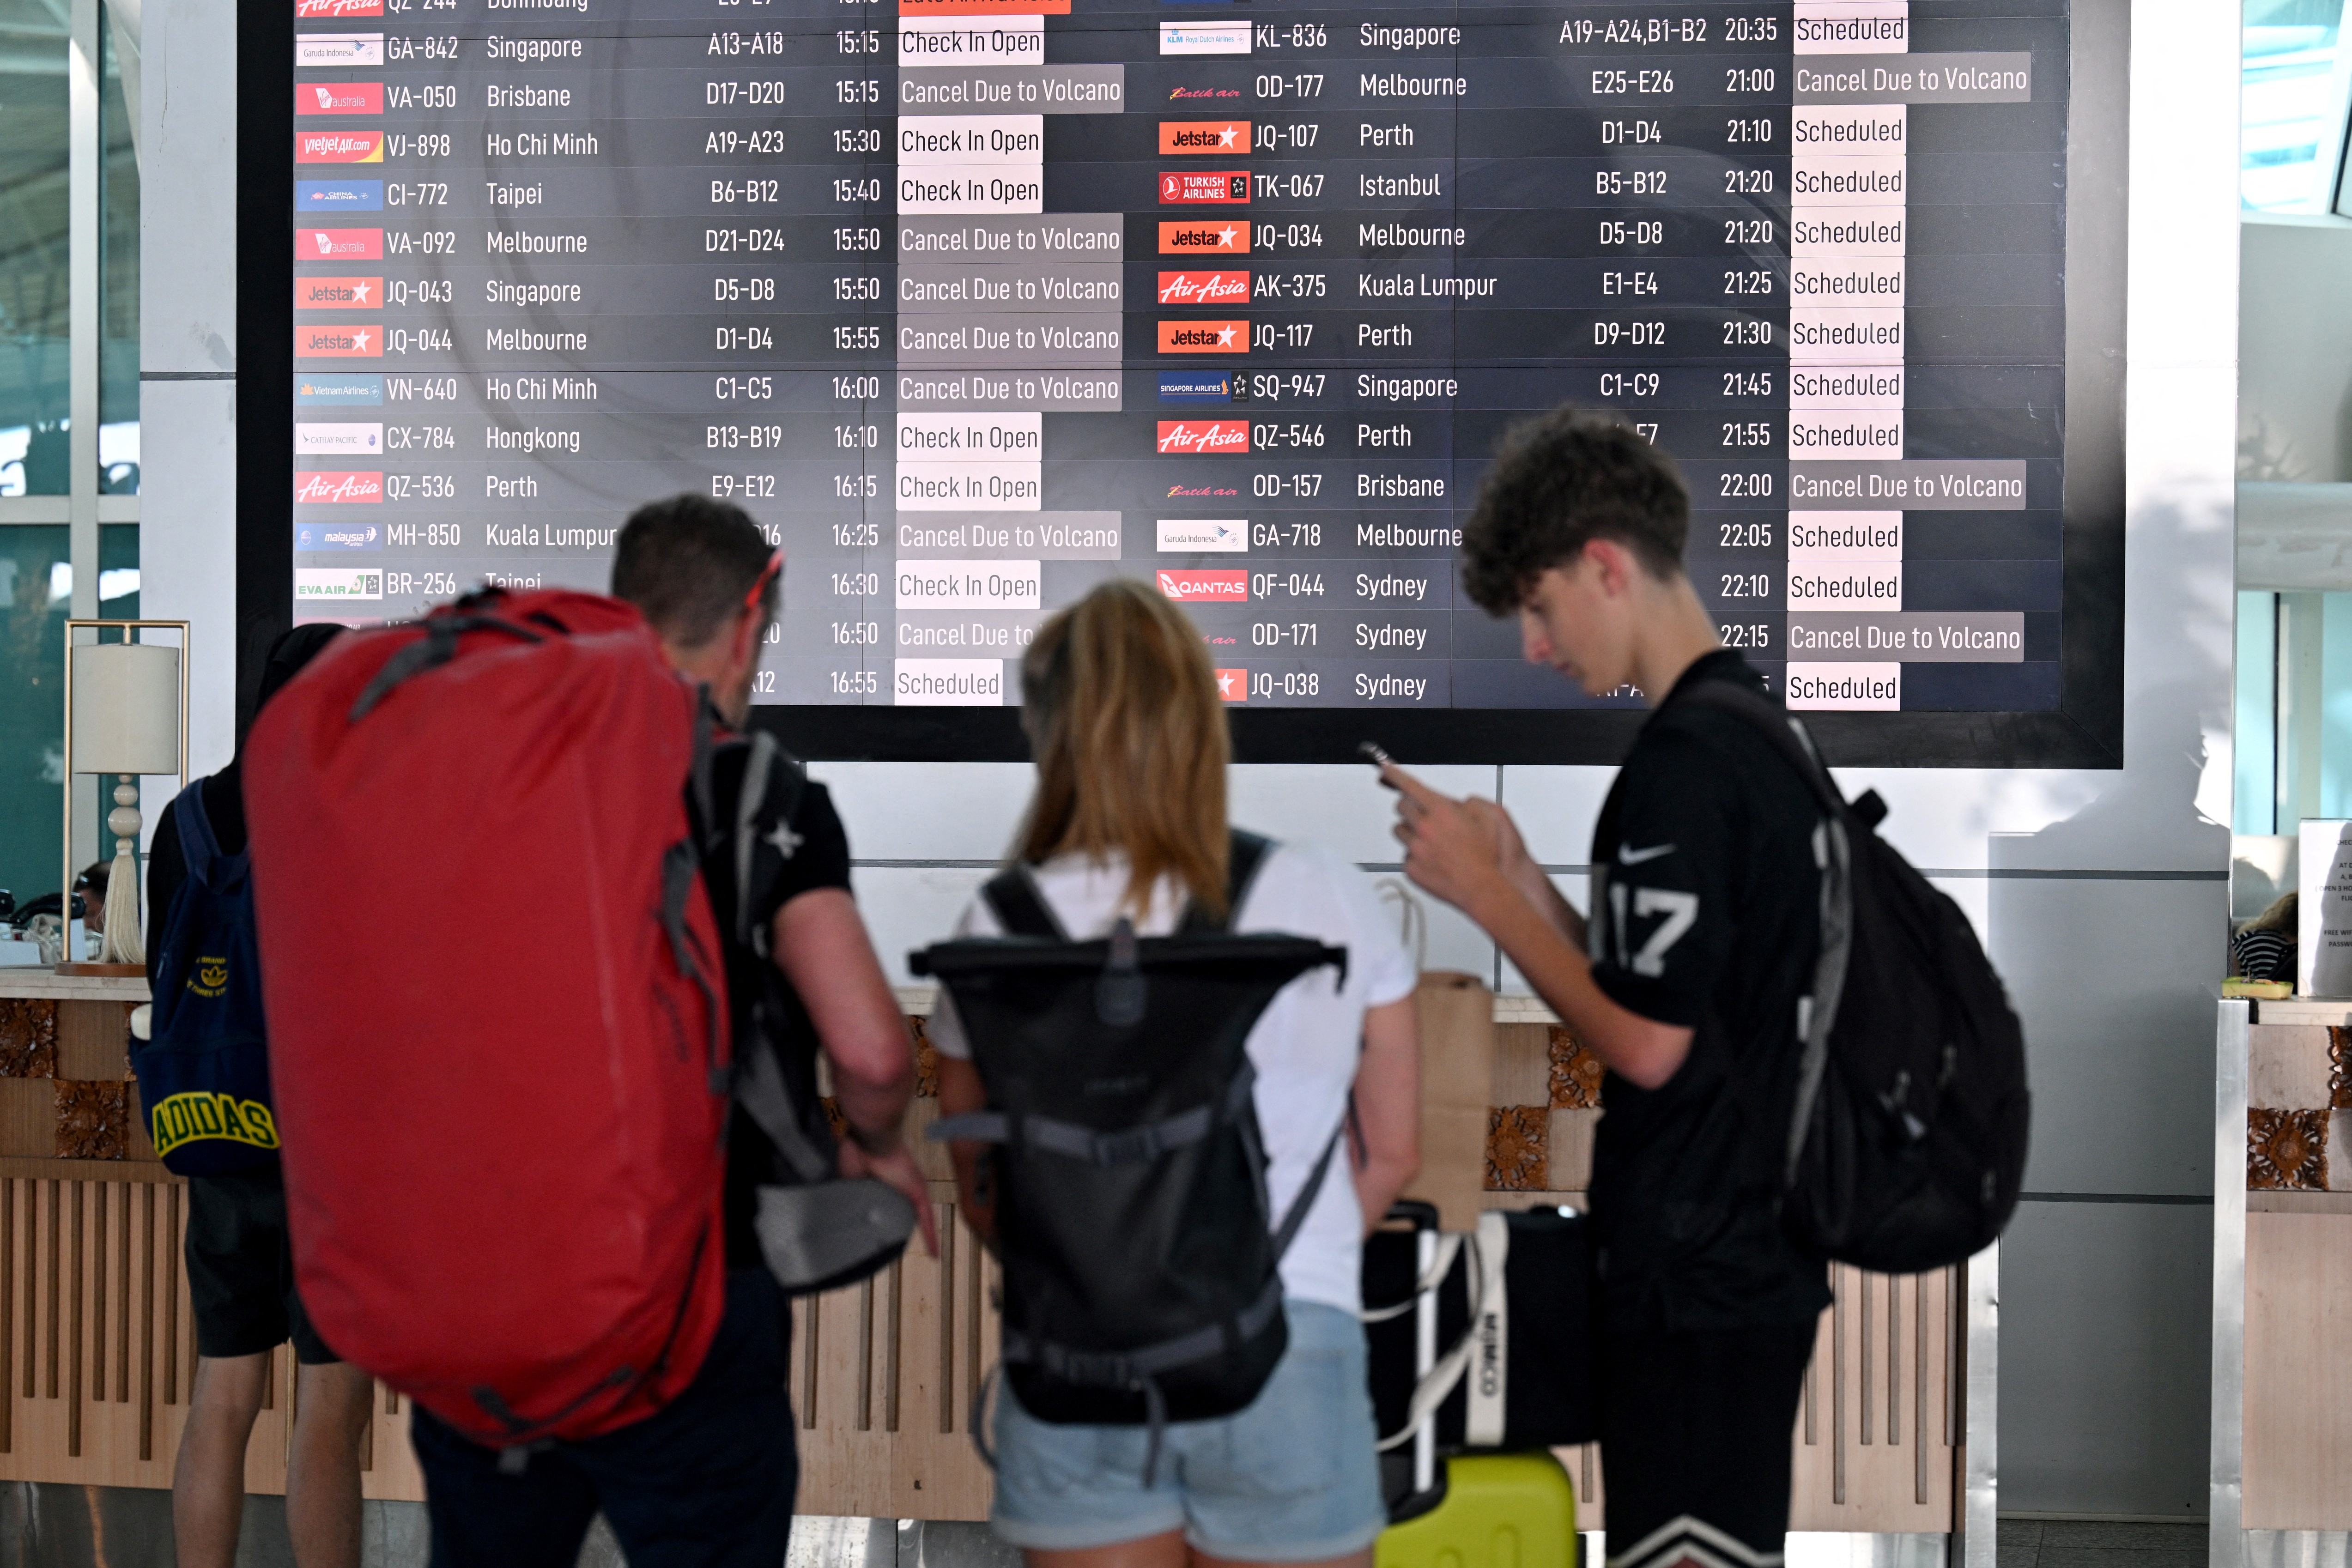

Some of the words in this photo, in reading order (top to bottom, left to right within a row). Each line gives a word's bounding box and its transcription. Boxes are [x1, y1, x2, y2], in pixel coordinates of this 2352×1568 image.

[1257, 24, 1327, 48] KL-836
[1360, 23, 1460, 50] Singapore
[1559, 18, 1706, 46] A19-A24,B1-B2
[1725, 17, 1777, 41] 20:35
[1797, 18, 1903, 41] Scheduled
[303, 49, 325, 57] Garuda
[388, 36, 458, 60] GA-842
[487, 36, 582, 62] Singapore
[708, 31, 783, 55] A13-A18
[837, 30, 879, 54] 15:15
[902, 80, 969, 103] Cancel
[975, 80, 1011, 102] Due
[1017, 81, 1037, 102] to
[1042, 79, 1119, 101] Volcano
[1256, 74, 1324, 97] OD-177
[1361, 73, 1466, 96] Melbourne
[1592, 70, 1673, 93] E25-E26
[1727, 68, 1774, 91] 21:00
[1797, 69, 1867, 92] Cancel
[1874, 68, 1912, 91] Due
[1918, 69, 1939, 90] to
[1945, 67, 2027, 90] Volcano
[332, 96, 365, 107] australia
[388, 85, 456, 108] VA-050
[488, 85, 570, 107] Brisbane
[707, 81, 784, 104] D17-D20
[836, 80, 879, 103] 15:15
[705, 130, 783, 153] A19-A23
[834, 129, 880, 152] 15:30
[902, 130, 962, 152] Check
[969, 130, 984, 151] In
[991, 129, 1038, 155] Open
[1173, 131, 1221, 146] Jetstar
[1255, 124, 1318, 151] JQ-107
[1360, 123, 1413, 146] Perth
[1602, 121, 1661, 144] D1-D4
[1727, 119, 1771, 142] 21:10
[1796, 119, 1902, 142] Scheduled
[387, 134, 450, 157] VJ-898
[488, 134, 511, 156] Ho
[517, 133, 546, 155] Chi
[553, 133, 598, 155] Minh
[712, 180, 778, 203] B6-B12
[833, 179, 880, 201] 15:40
[1183, 177, 1224, 187] TURKISH
[1183, 188, 1224, 199] AIRLINES
[1255, 175, 1324, 197] TK-067
[1360, 173, 1441, 196] Istanbul
[1597, 171, 1667, 194] B5-B12
[388, 183, 448, 206] CI-772
[486, 182, 541, 209] Taipei
[487, 231, 587, 253] Melbourne
[706, 229, 785, 251] D21-D24
[1172, 230, 1220, 246] Jetstar
[1255, 224, 1323, 251] JQ-034
[1359, 224, 1465, 246] Melbourne
[1725, 220, 1772, 243] 21:20
[332, 242, 364, 252] australia
[308, 286, 355, 301] Jetstar
[387, 280, 452, 306] JQ-043
[486, 280, 581, 306] Singapore
[715, 278, 774, 301] D5-D8
[833, 277, 879, 300] 15:50
[1254, 274, 1326, 297] AK-375
[1359, 274, 1414, 297] Kuala
[1421, 273, 1497, 300] Lumpur
[1603, 272, 1658, 295] E1-E4
[308, 334, 354, 349] Jetstar
[487, 328, 587, 351] Melbourne
[1171, 330, 1219, 345] Jetstar
[1359, 323, 1412, 346] Perth
[1595, 322, 1665, 345] D9-D12
[387, 378, 456, 400] VN-640
[716, 377, 771, 399] C1-C5
[832, 376, 879, 399] 16:00
[1254, 375, 1325, 401] SQ-947
[1358, 374, 1457, 401] Singapore
[1600, 373, 1659, 396] C1-C9
[1723, 373, 1771, 395] 21:45
[388, 427, 455, 448] CX-784
[487, 426, 580, 453] Hongkong
[707, 426, 782, 448] B13-B19
[835, 425, 877, 448] 16:10
[901, 427, 960, 448] Check
[967, 427, 982, 448] In
[990, 426, 1037, 452] Open
[1254, 424, 1324, 451] QZ-546
[388, 475, 454, 501] QZ-536
[487, 475, 537, 497] Perth
[713, 475, 775, 497] E9-E12
[1358, 474, 1444, 496] Brisbane
[1721, 473, 1772, 496] 22:00
[324, 532, 364, 545] malaysia
[388, 524, 460, 545] MH-850
[487, 524, 539, 546] Kuala
[546, 524, 617, 550] Lumpur
[832, 524, 878, 546] 16:25
[1164, 534, 1187, 543] Garuda
[1188, 534, 1217, 543] Indonesia
[1253, 524, 1321, 546] GA-718
[1792, 525, 1898, 547] Scheduled
[388, 572, 456, 594] BR-256
[1179, 581, 1245, 593] QANTAS
[1253, 574, 1324, 600] QF-044
[1356, 574, 1427, 600] Sydney
[1721, 574, 1769, 597] 22:10
[1252, 623, 1316, 646] OD-171
[1721, 624, 1768, 647] 22:15
[831, 671, 877, 693] 16:55
[898, 672, 999, 695] Scheduled
[1790, 677, 1896, 699] Scheduled
[152, 1091, 281, 1158] ADIDAS
